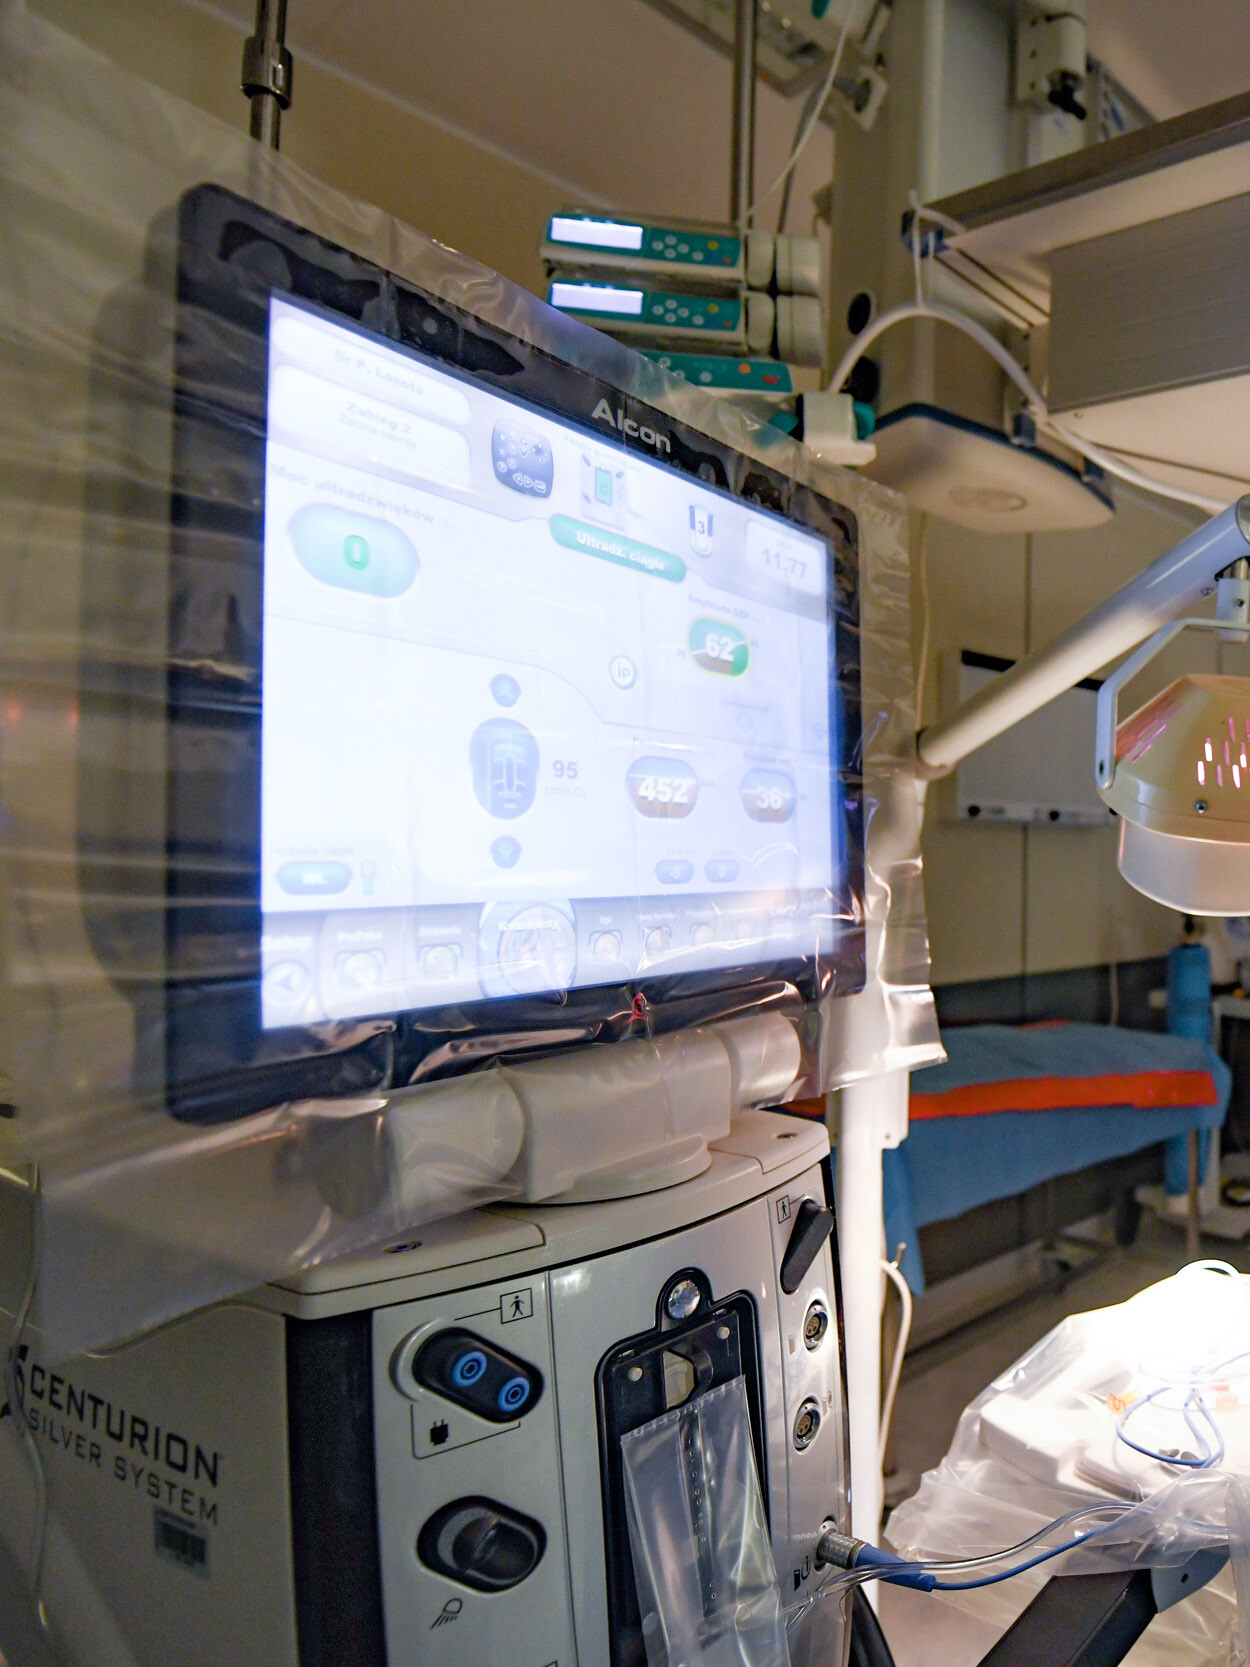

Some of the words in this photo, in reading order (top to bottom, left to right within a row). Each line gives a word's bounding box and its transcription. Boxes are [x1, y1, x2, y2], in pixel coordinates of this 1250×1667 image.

[591, 398, 671, 453] Alcon
[698, 521, 706, 535] 3
[344, 534, 370, 571] 0
[705, 633, 735, 662] 62
[552, 760, 579, 780] 95
[638, 778, 690, 804] 452
[30, 1363, 220, 1489] CENTURION
[28, 1407, 103, 1469] SILVER
[113, 1455, 219, 1527] SYSTEM
